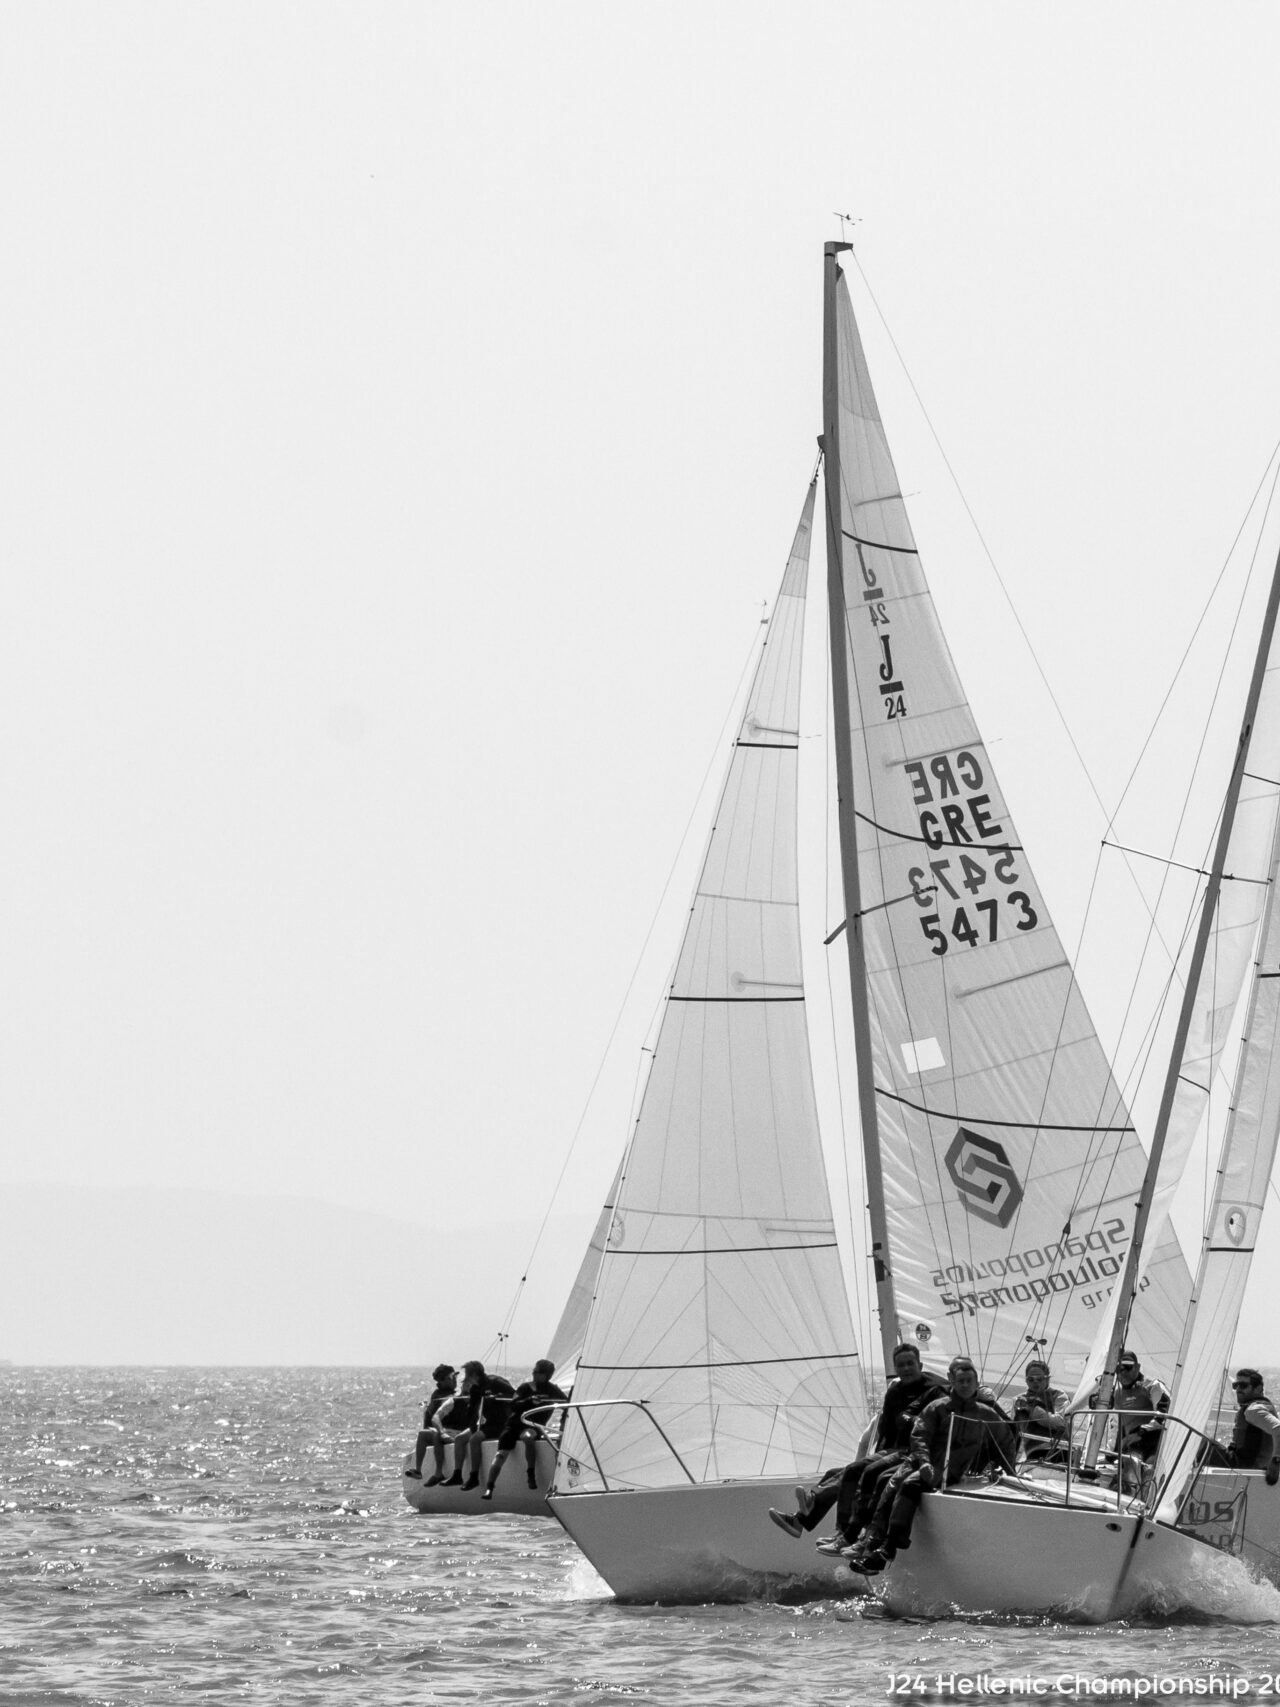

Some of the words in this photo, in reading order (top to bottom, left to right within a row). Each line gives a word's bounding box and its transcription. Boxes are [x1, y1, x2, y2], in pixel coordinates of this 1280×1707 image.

[879, 634, 894, 682] J
[884, 694, 907, 720] 24
[919, 793, 1003, 851] GRE
[919, 890, 1038, 956] 5473
